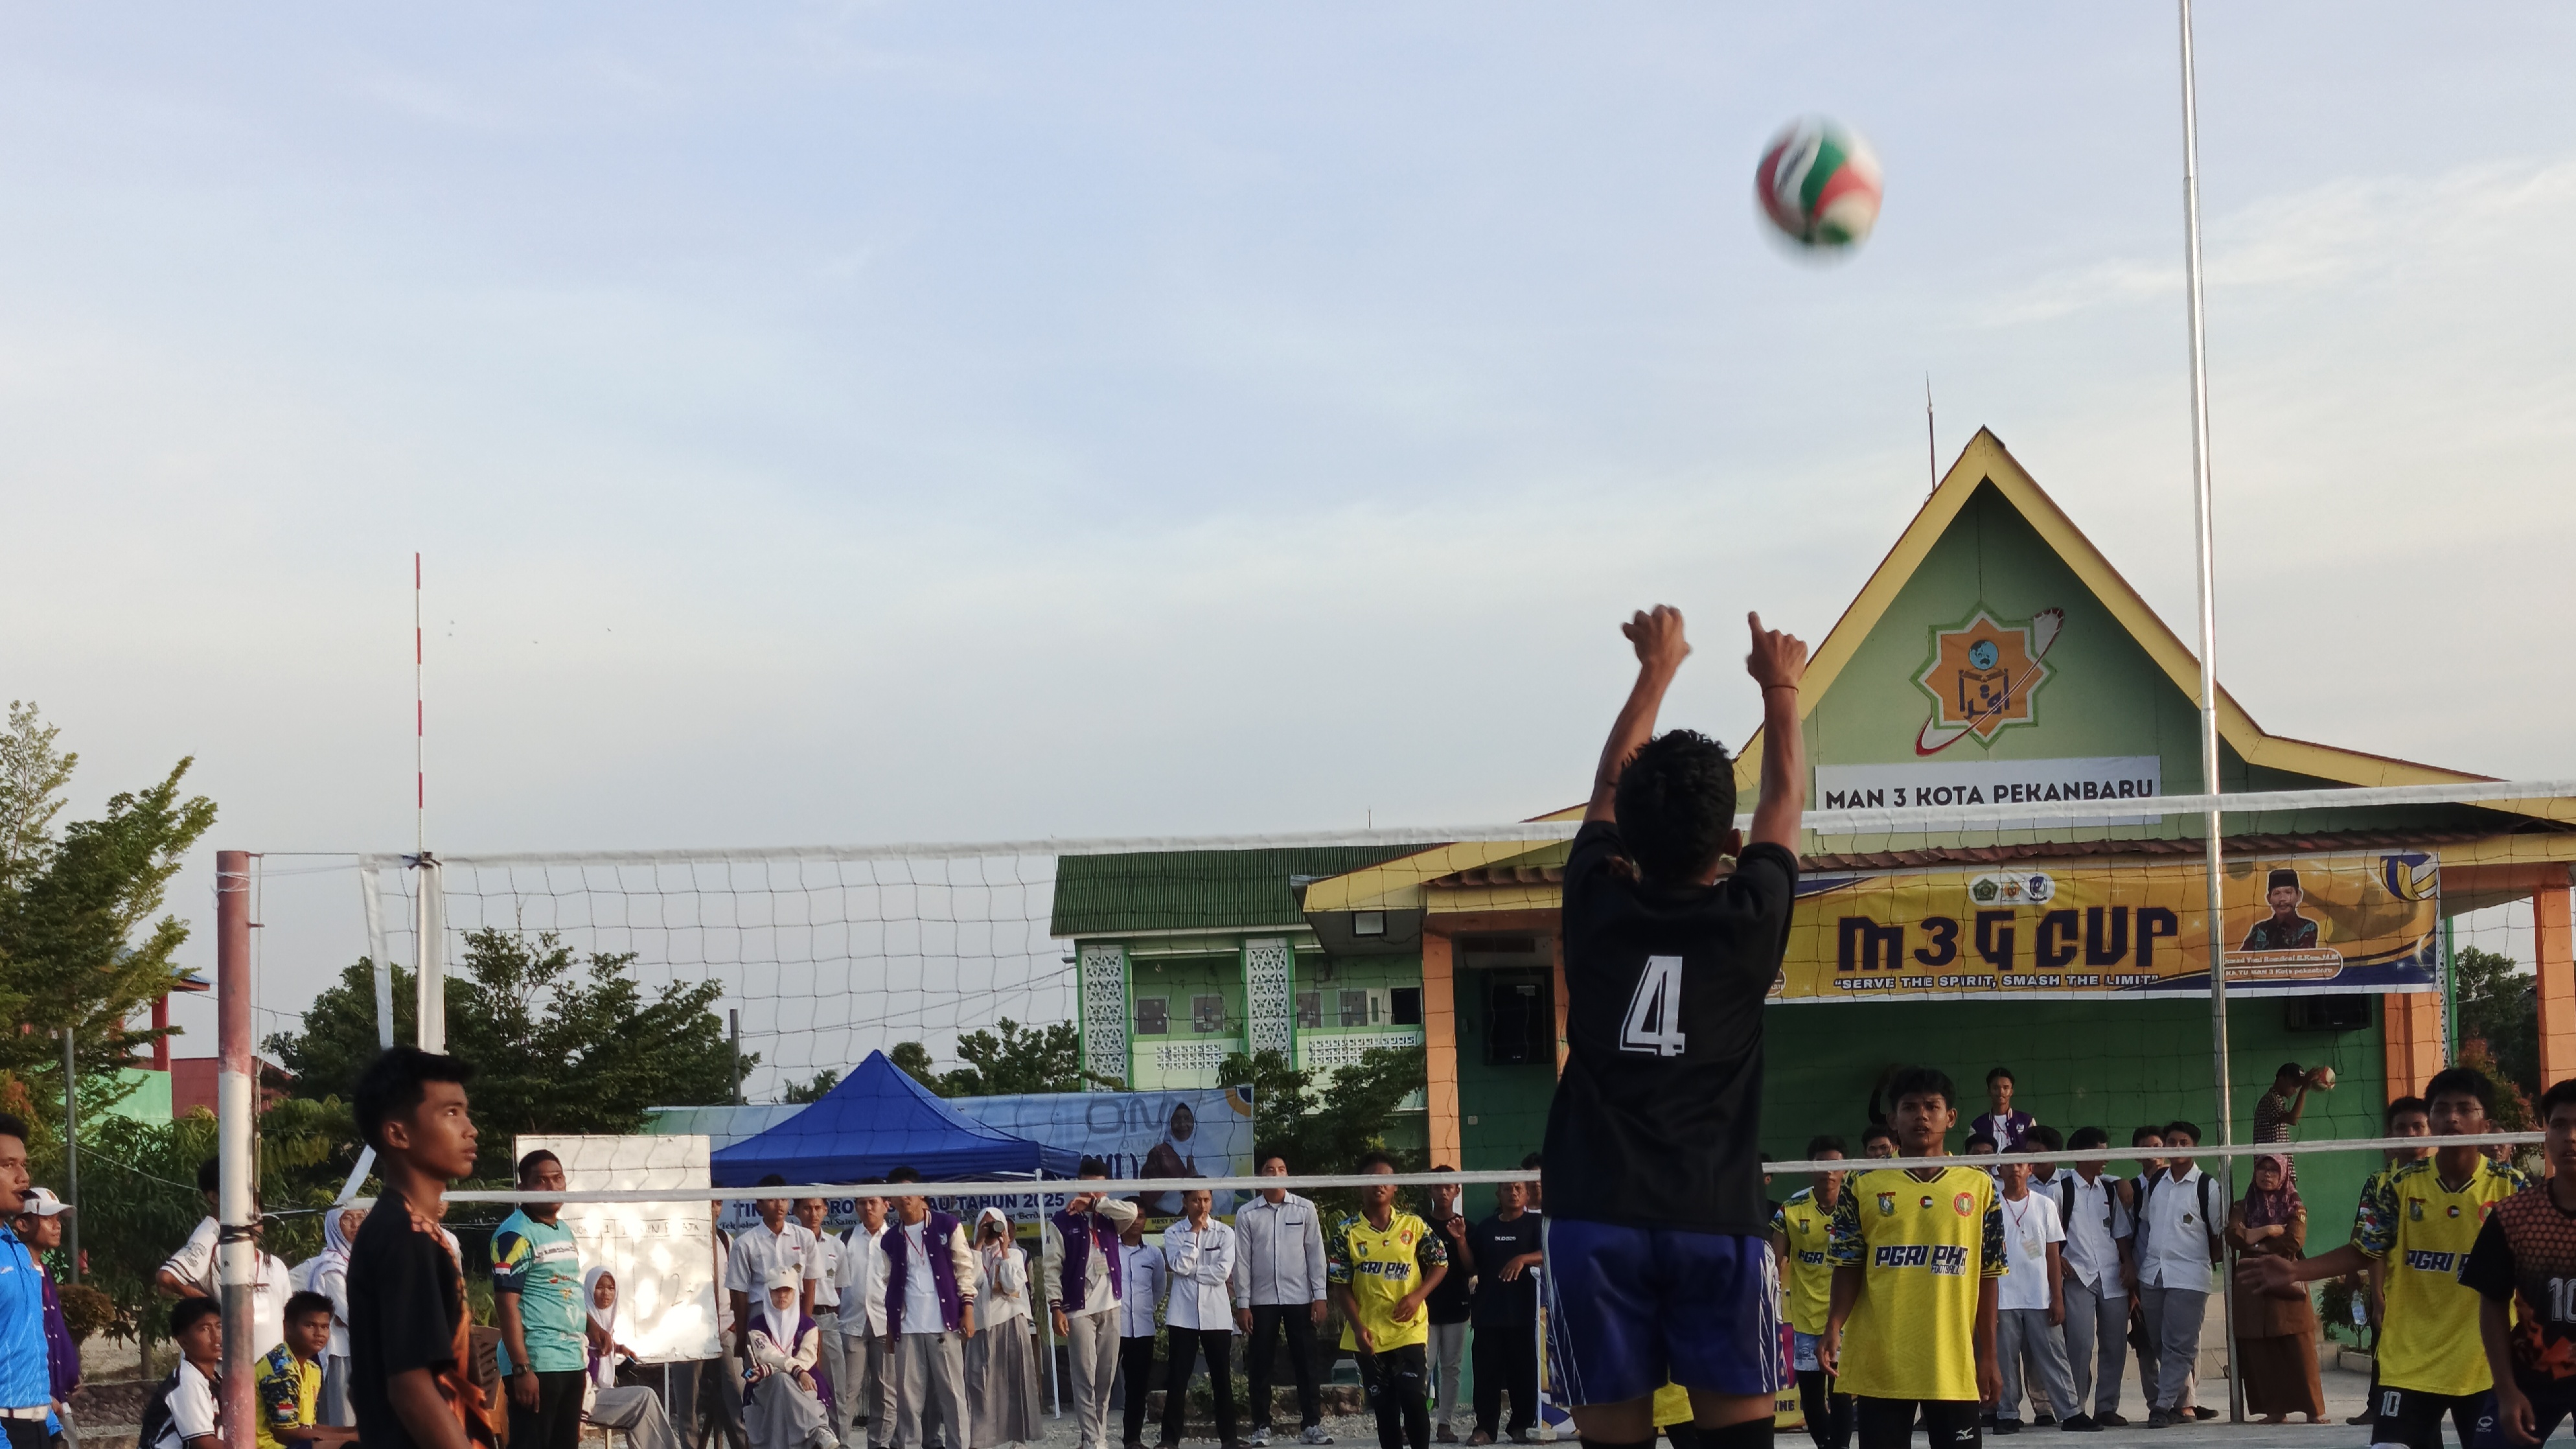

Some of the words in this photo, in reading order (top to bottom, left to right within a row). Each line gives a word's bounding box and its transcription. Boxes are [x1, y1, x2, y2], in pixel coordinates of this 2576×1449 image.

[1826, 789, 1884, 809] MAN
[1893, 787, 1907, 807] 3
[1916, 785, 1984, 807] KOTA
[1994, 780, 2154, 804] PEKANBARU
[2036, 906, 2179, 968] CUP
[1900, 976, 1934, 989] THE
[1938, 975, 1997, 990] SPIRIT,
[2002, 975, 2061, 987] SMASH
[2066, 974, 2099, 986] THE
[1620, 955, 1686, 1057] 4
[956, 1195, 1017, 1211] TAHUN
[1875, 1246, 1931, 1266] PGRI
[2380, 1391, 2402, 1417] 10
